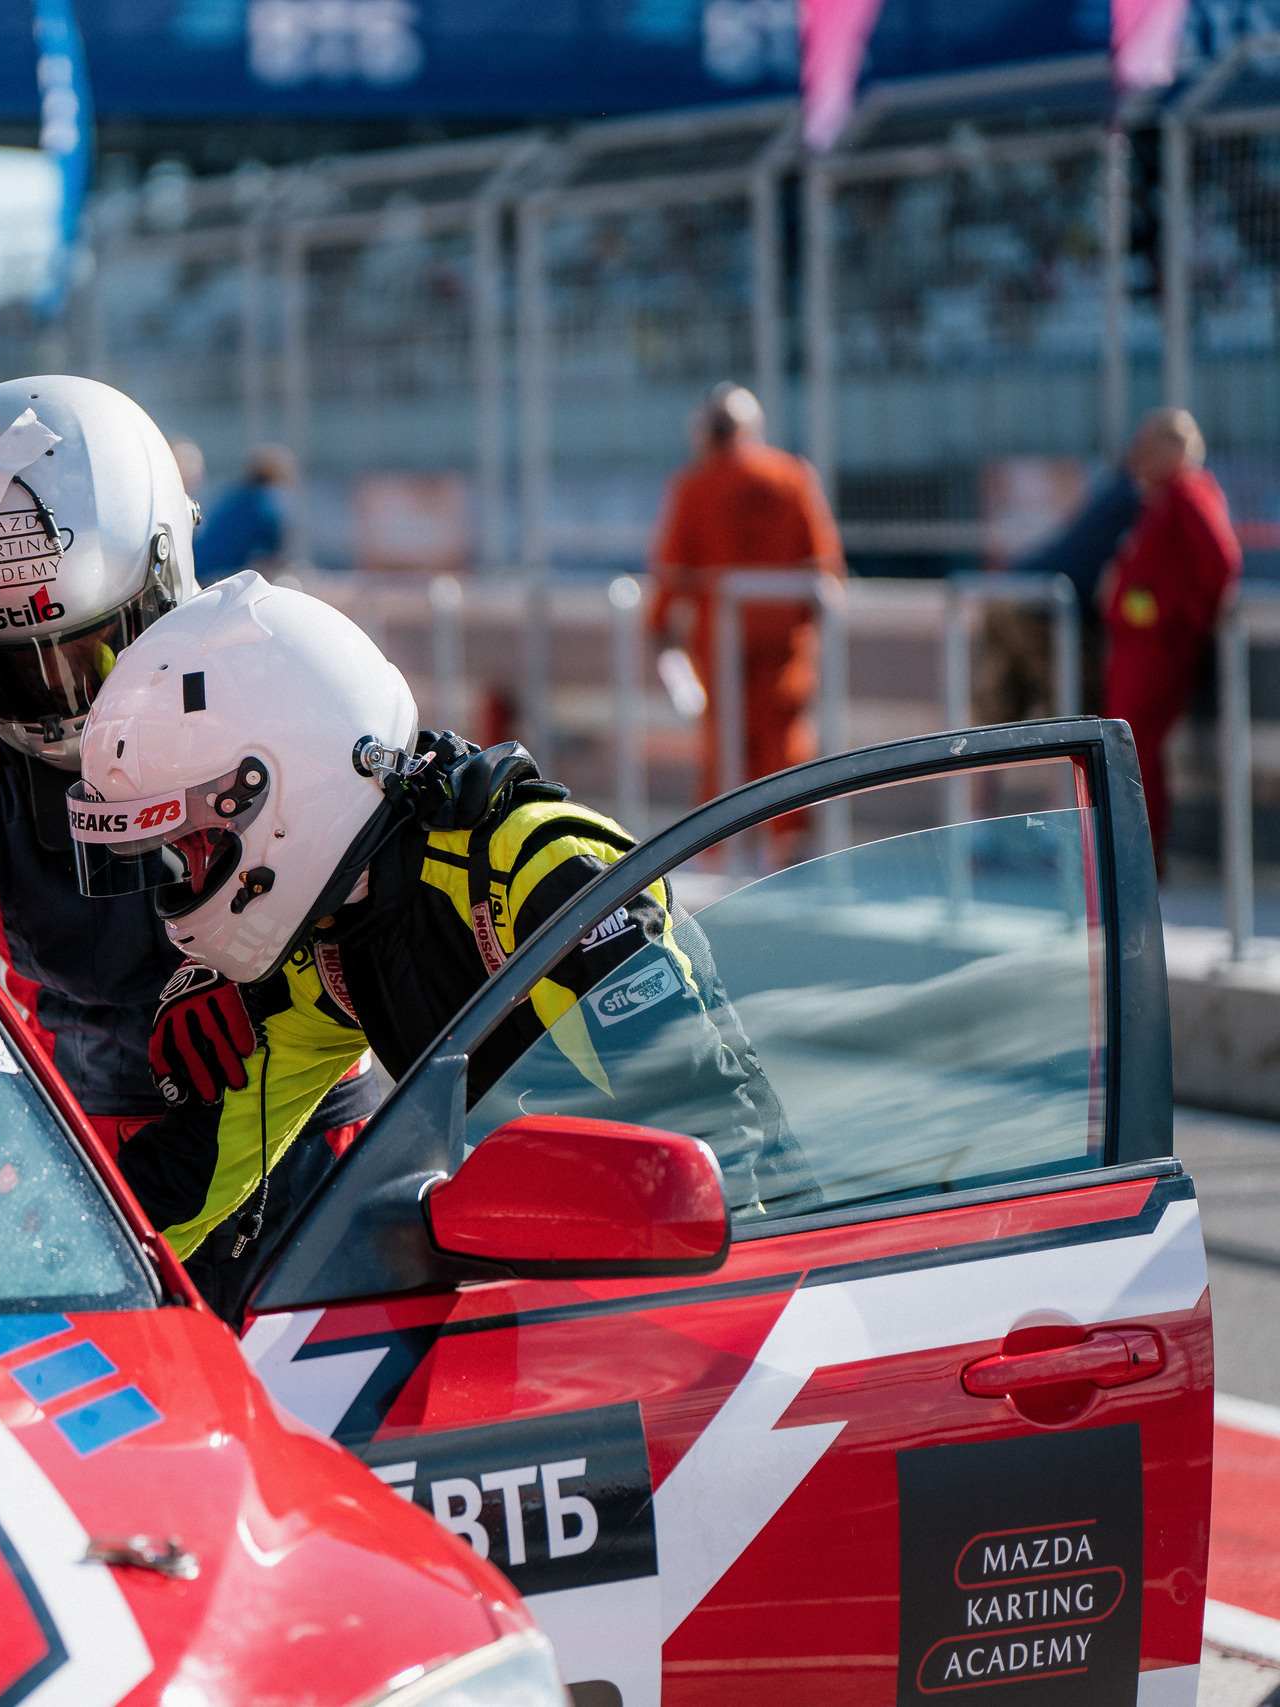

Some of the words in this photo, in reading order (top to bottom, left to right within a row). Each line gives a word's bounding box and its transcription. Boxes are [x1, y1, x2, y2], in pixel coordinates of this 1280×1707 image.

[429, 1457, 599, 1567] ВТБ
[982, 1534, 1094, 1575] MAZDA
[966, 1583, 1094, 1627] KARTING
[943, 1633, 1093, 1681] ACADEMY
